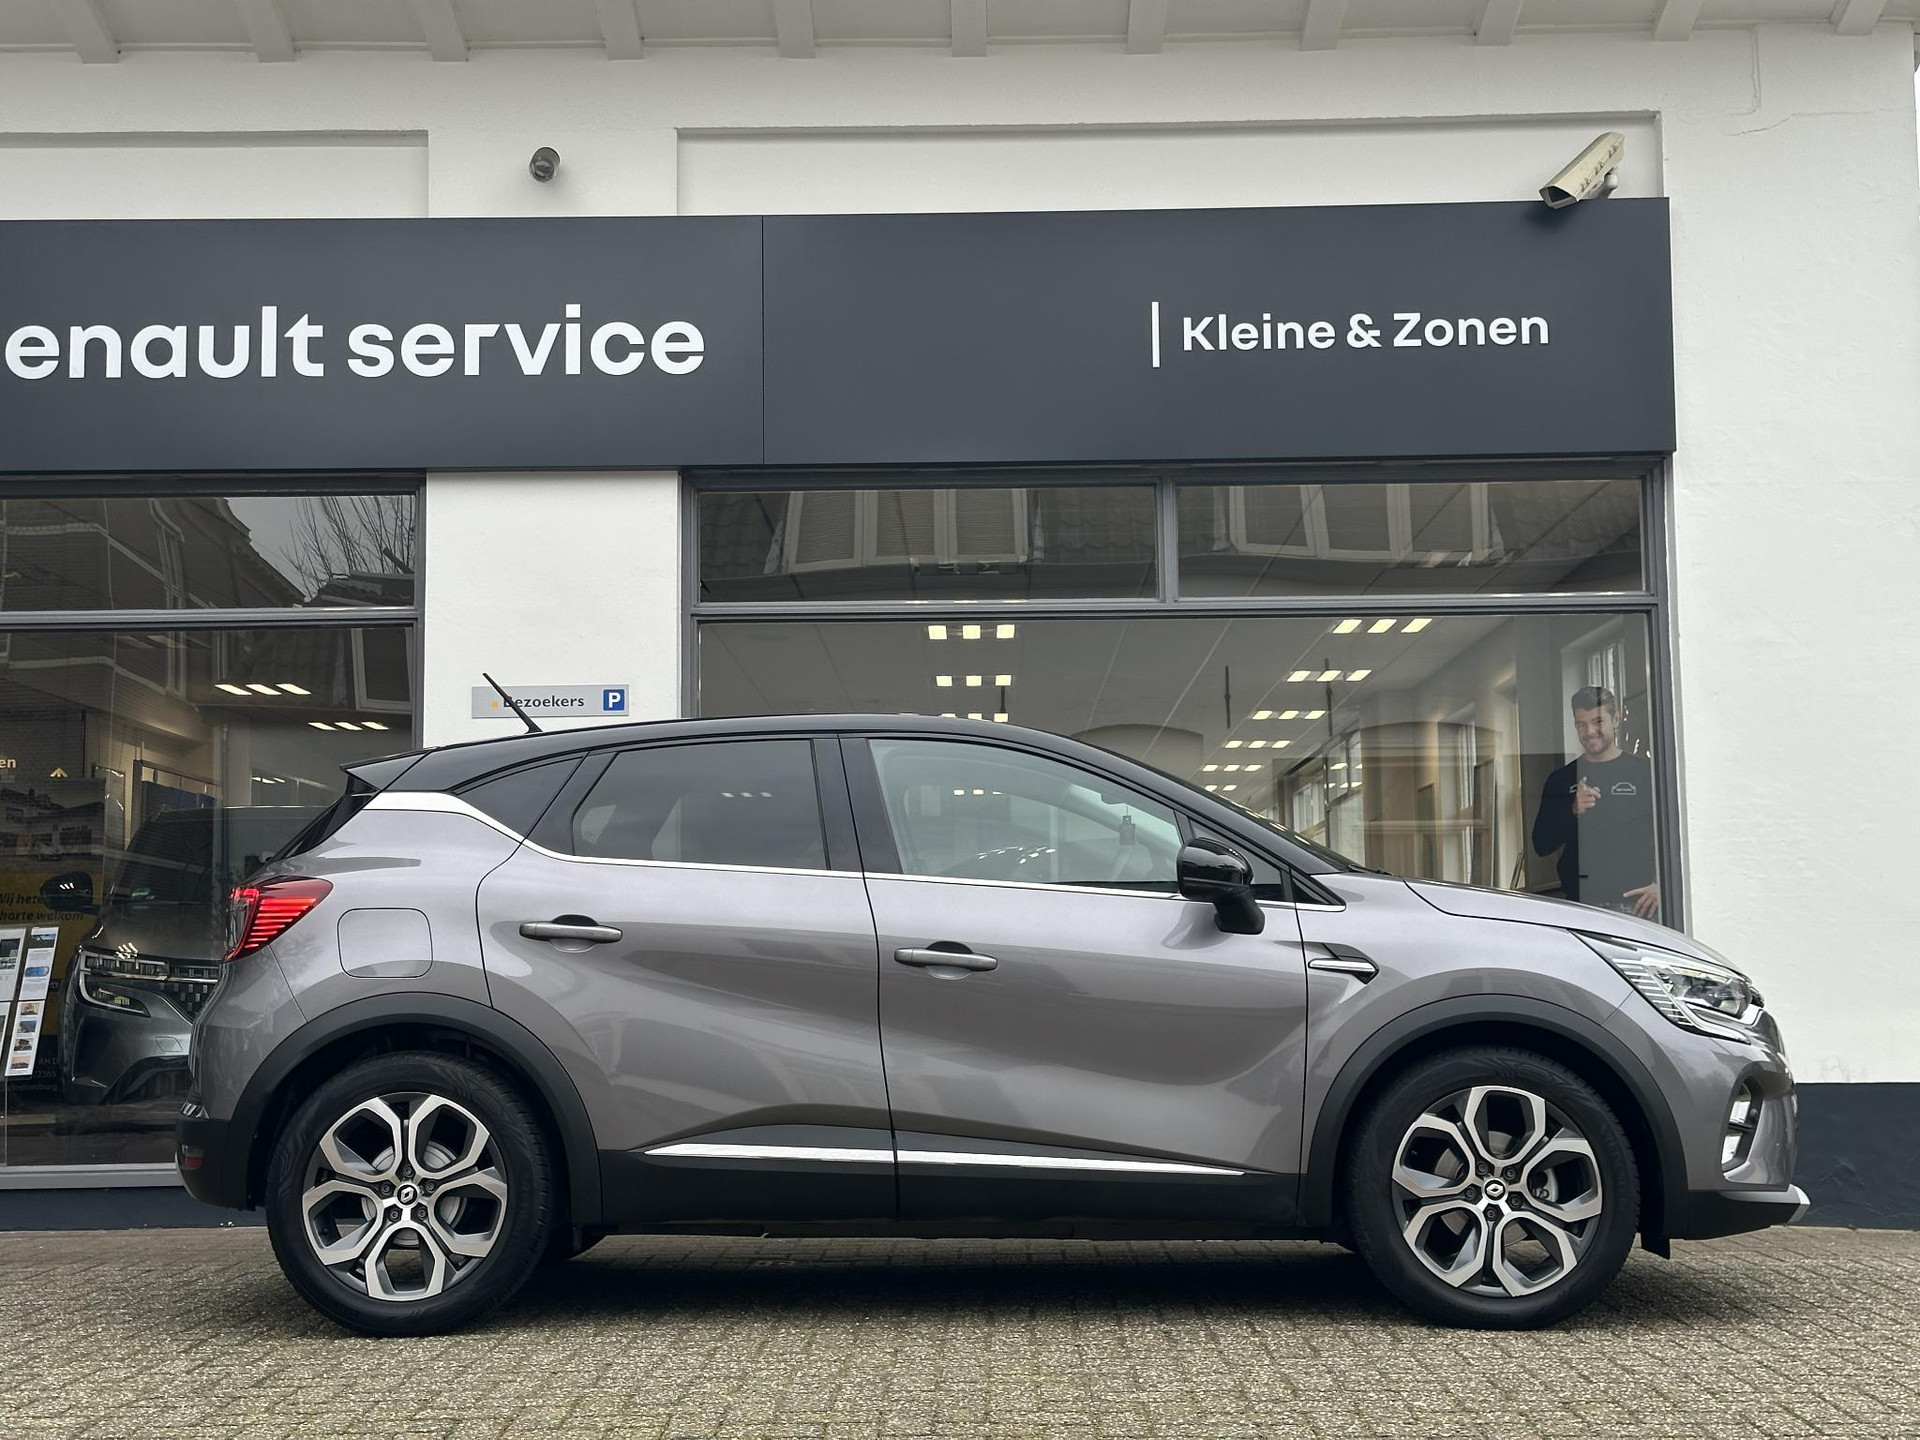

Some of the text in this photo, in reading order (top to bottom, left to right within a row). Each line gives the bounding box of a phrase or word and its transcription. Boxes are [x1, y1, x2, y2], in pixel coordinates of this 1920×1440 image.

[4, 302, 706, 380] enault service
[1182, 312, 1551, 352] Kleine & Zonen
